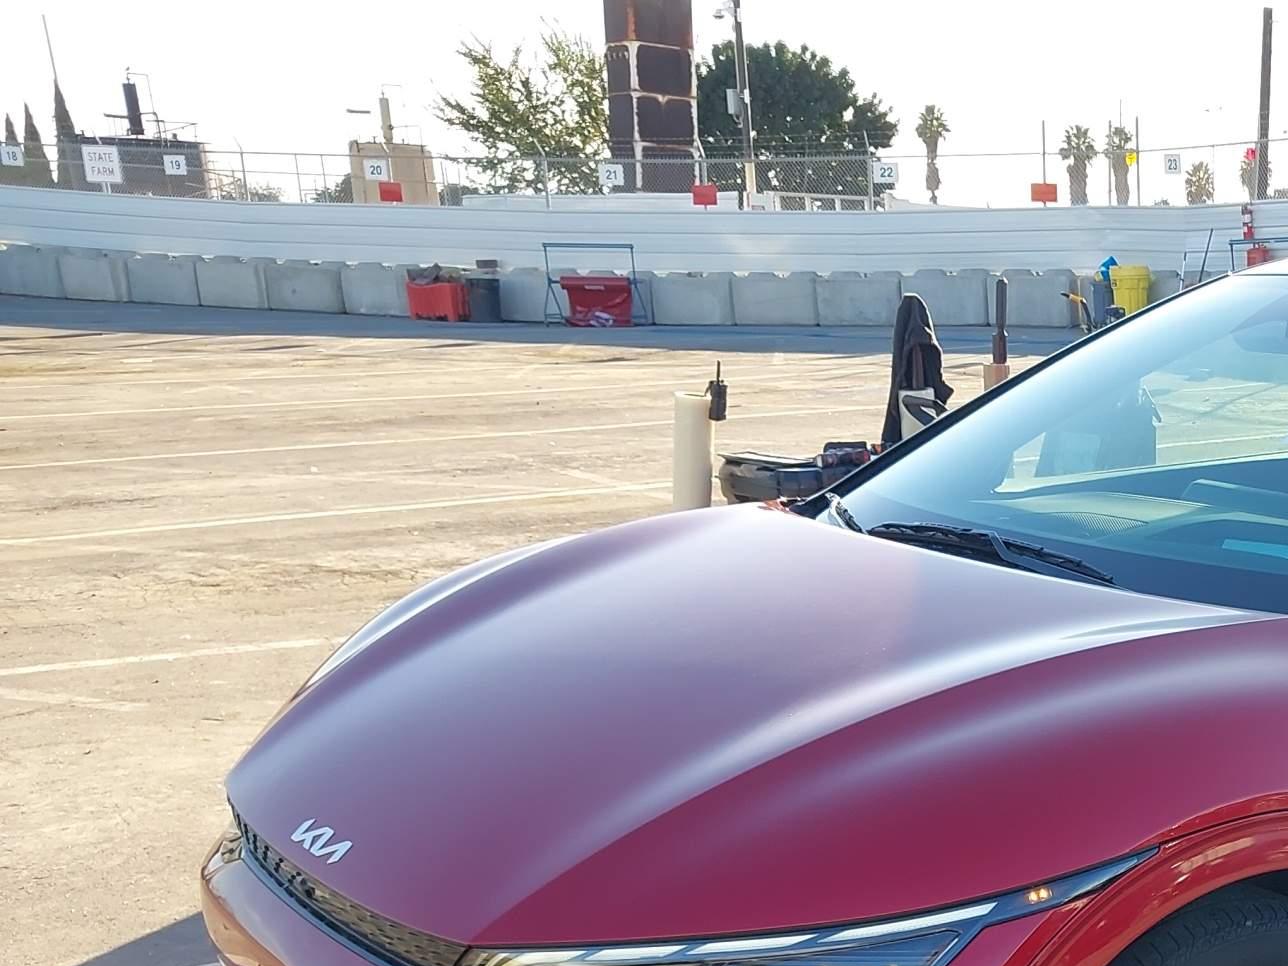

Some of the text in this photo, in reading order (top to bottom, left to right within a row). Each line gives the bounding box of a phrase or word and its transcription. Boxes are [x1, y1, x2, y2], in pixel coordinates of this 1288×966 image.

[7, 151, 17, 161] 18
[88, 152, 113, 162] STATE
[170, 160, 180, 170] 19
[1167, 158, 1178, 170] 23
[91, 166, 114, 176] FARM
[369, 164, 382, 176] 20
[606, 169, 617, 180] 21
[880, 167, 893, 178] 22
[290, 818, 353, 865] KIA
